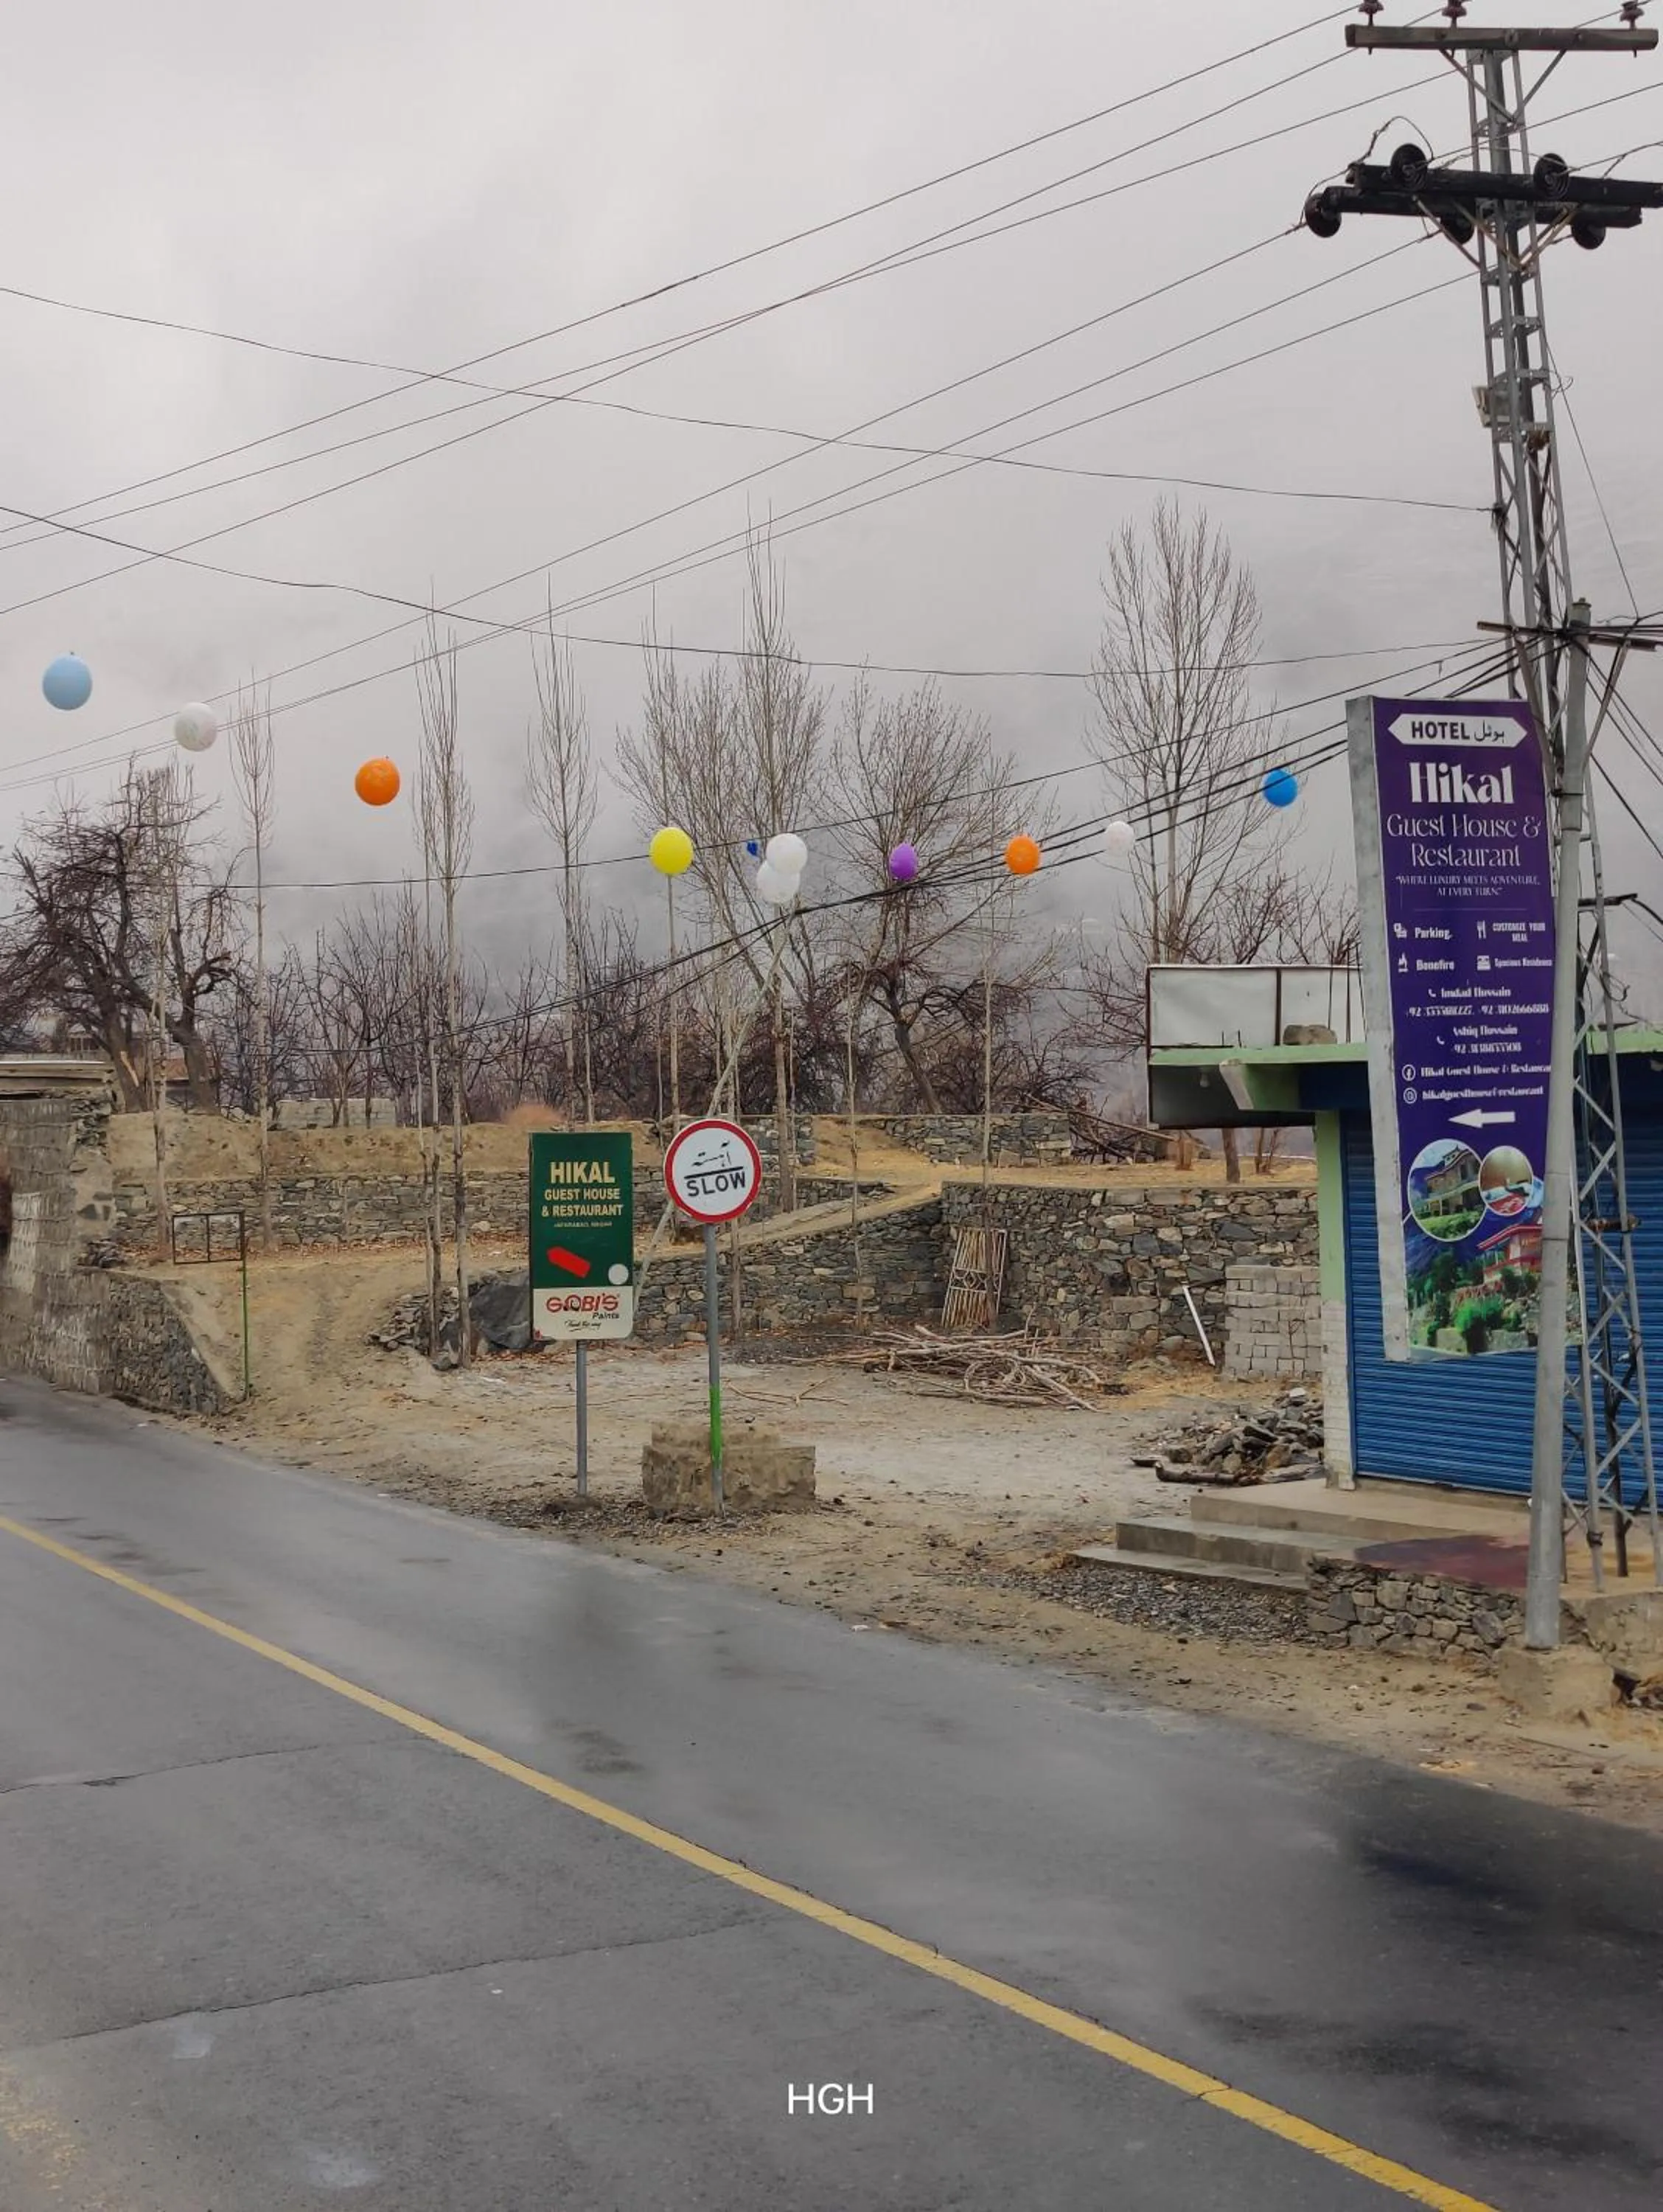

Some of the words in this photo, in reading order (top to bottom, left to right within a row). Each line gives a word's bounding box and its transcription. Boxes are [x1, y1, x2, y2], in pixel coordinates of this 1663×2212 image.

[1412, 721, 1471, 740] HOTEL
[1409, 762, 1514, 804] Hikal
[1387, 814, 1446, 837] Guest
[1452, 814, 1516, 837] House
[1524, 815, 1541, 838] &
[1412, 843, 1521, 867] Restaurant
[551, 1161, 616, 1183] HIKAL
[545, 1188, 580, 1201] GUEST
[583, 1188, 621, 1200] HOUSE
[686, 1171, 746, 1197] SLOW
[541, 1205, 549, 1217] &
[552, 1203, 624, 1217] RESTAURANT
